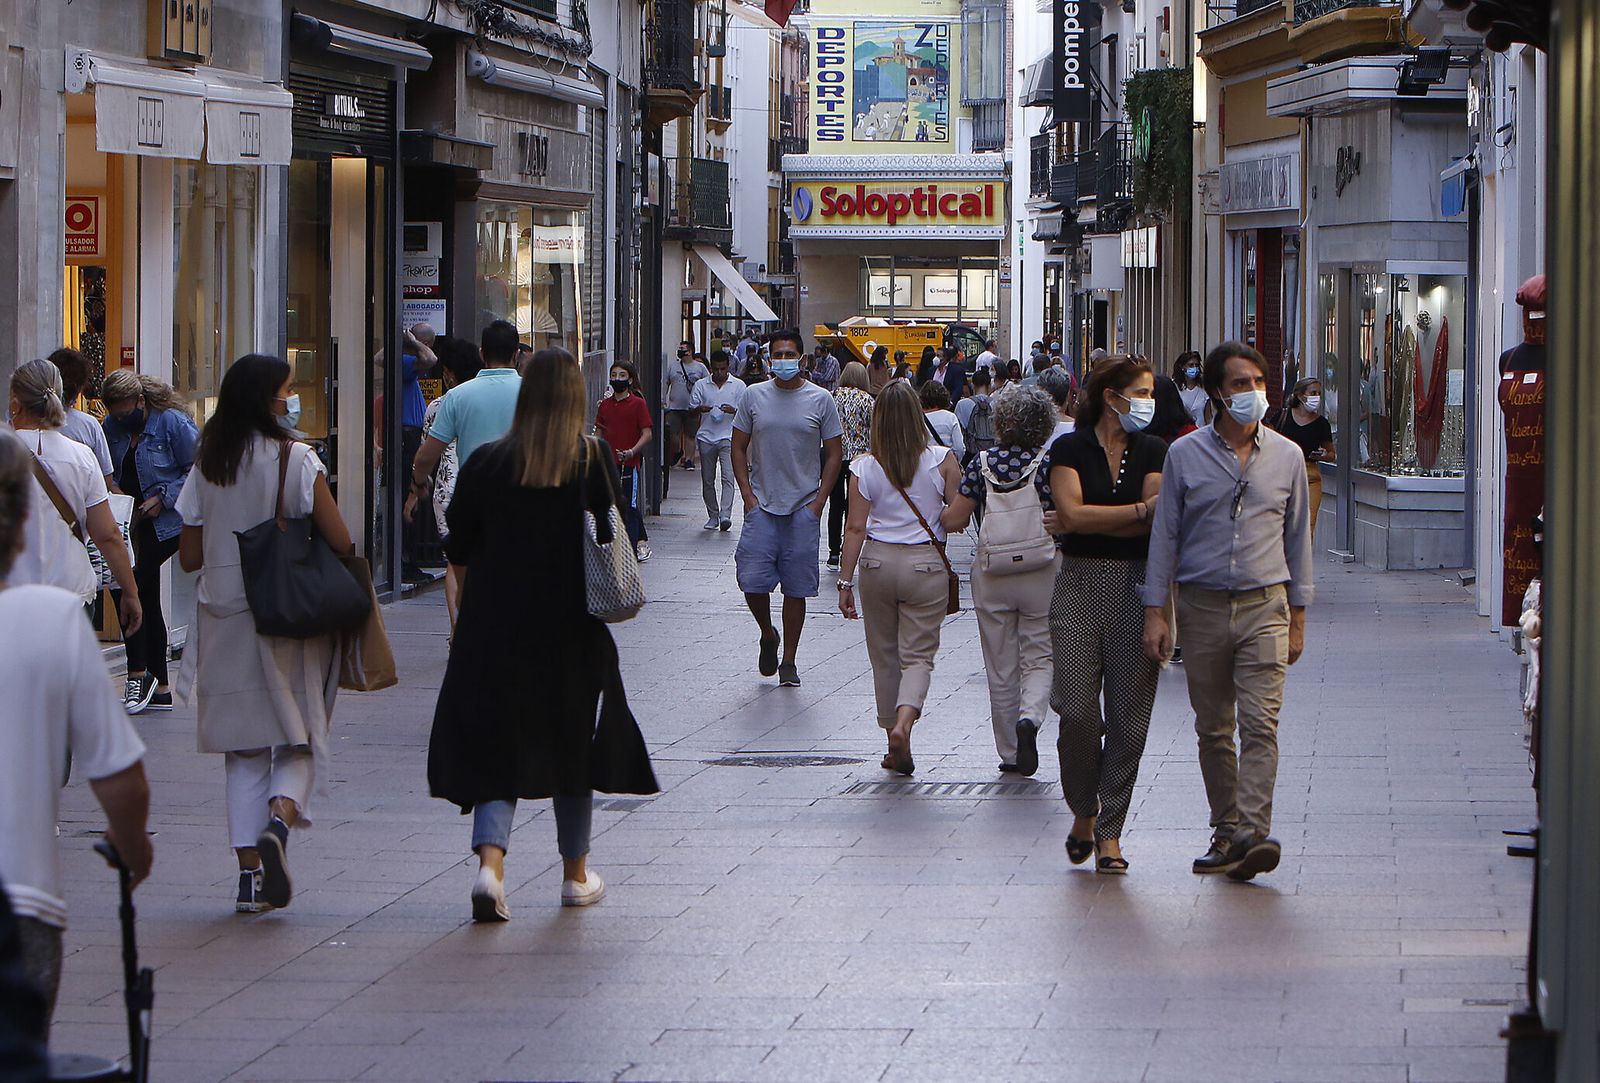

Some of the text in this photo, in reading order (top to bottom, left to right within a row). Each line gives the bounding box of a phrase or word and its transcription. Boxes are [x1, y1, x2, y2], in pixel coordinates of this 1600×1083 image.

[914, 24, 934, 47] Z
[816, 27, 845, 141] DEPORTES
[935, 24, 947, 140] DEPORTES
[820, 185, 993, 225] Soloptical
[850, 327, 869, 337] 1802
